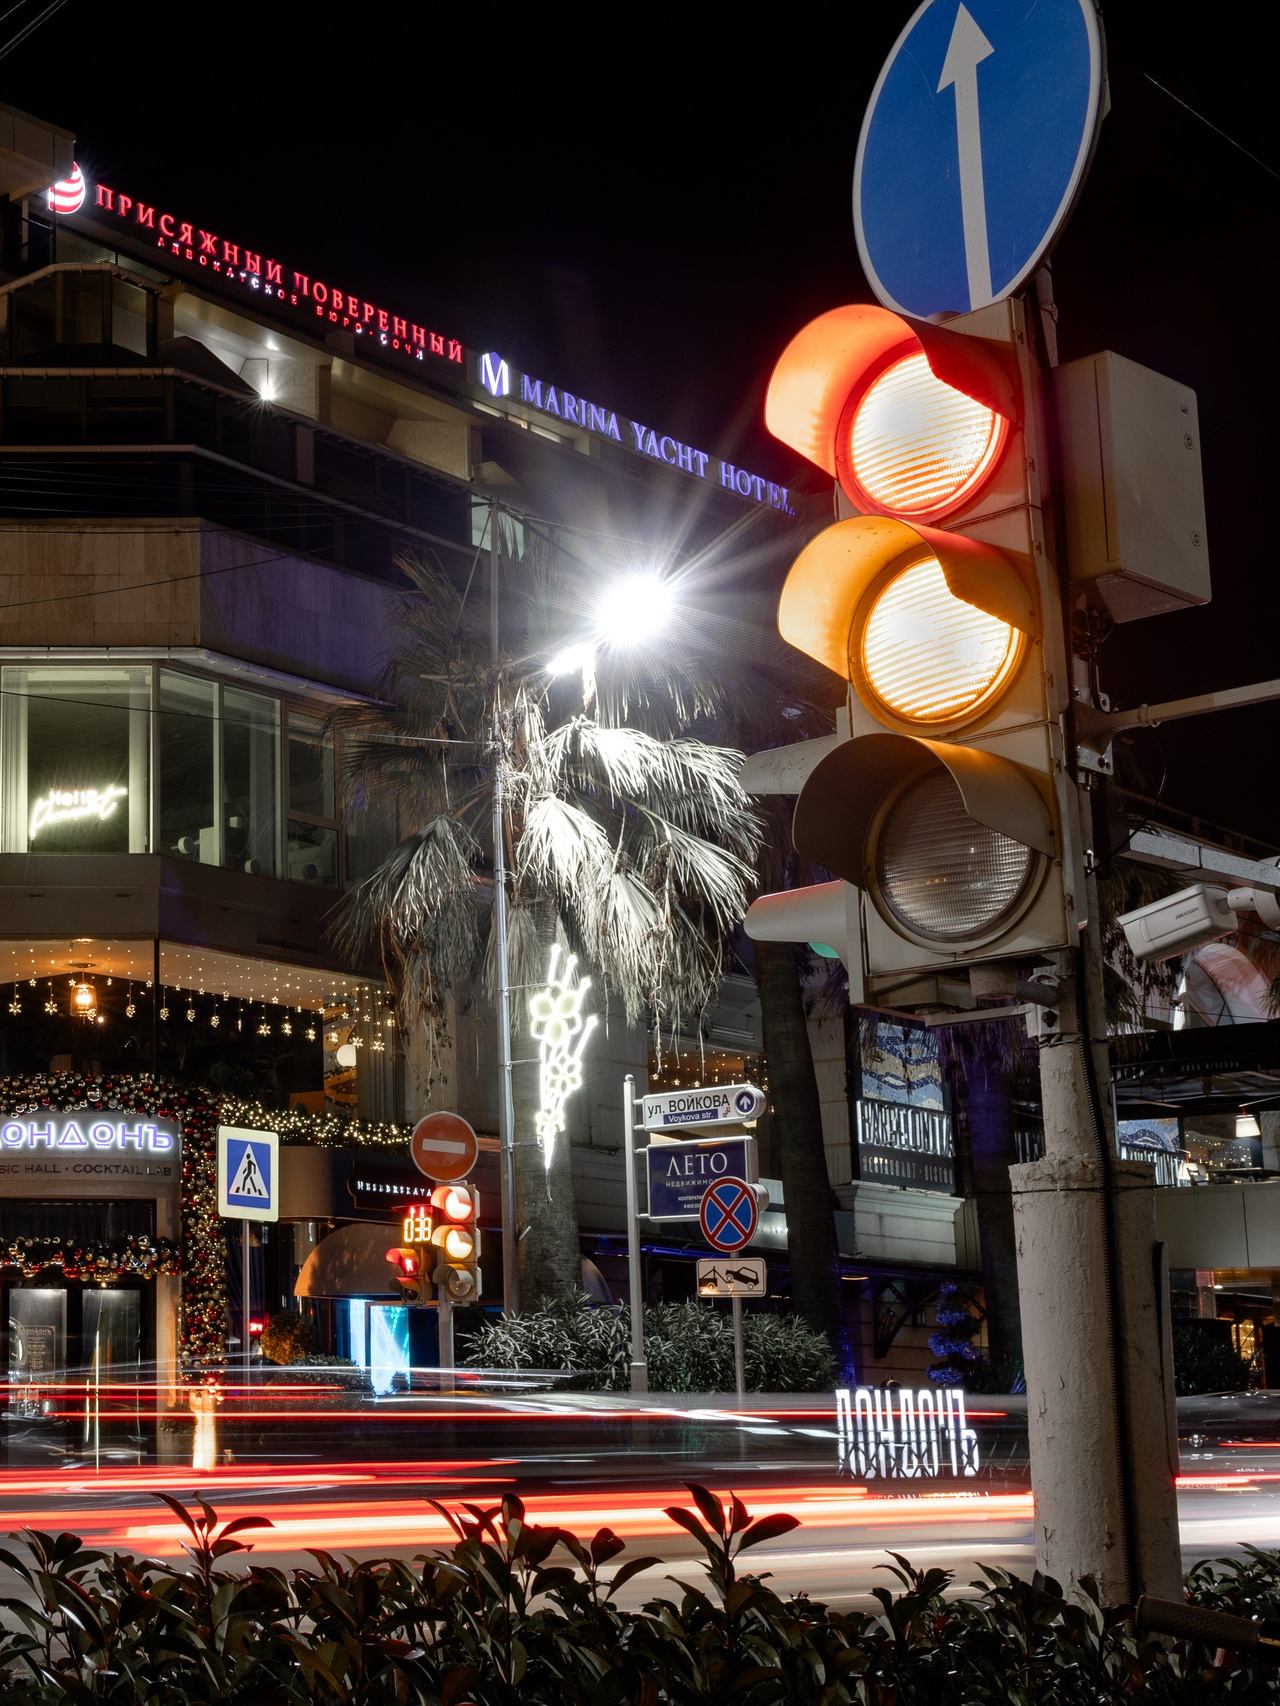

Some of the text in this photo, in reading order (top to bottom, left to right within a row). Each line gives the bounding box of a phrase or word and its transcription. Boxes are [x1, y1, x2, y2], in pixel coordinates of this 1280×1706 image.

[96, 184, 463, 364] ПРИСЯЖНЫЙ ПОВЕРЕННЫЙ
[157, 236, 298, 305] АДВОКАТСКОЕ
[522, 373, 622, 442] MARINA
[629, 420, 709, 479] YACHT
[647, 1094, 731, 1119] ул. ВОЙКОВА
[668, 1112, 715, 1124] Voykova str.
[24, 1163, 62, 1174] HALL
[73, 1163, 144, 1175] COCKTAIL
[145, 1166, 173, 1177] LAB
